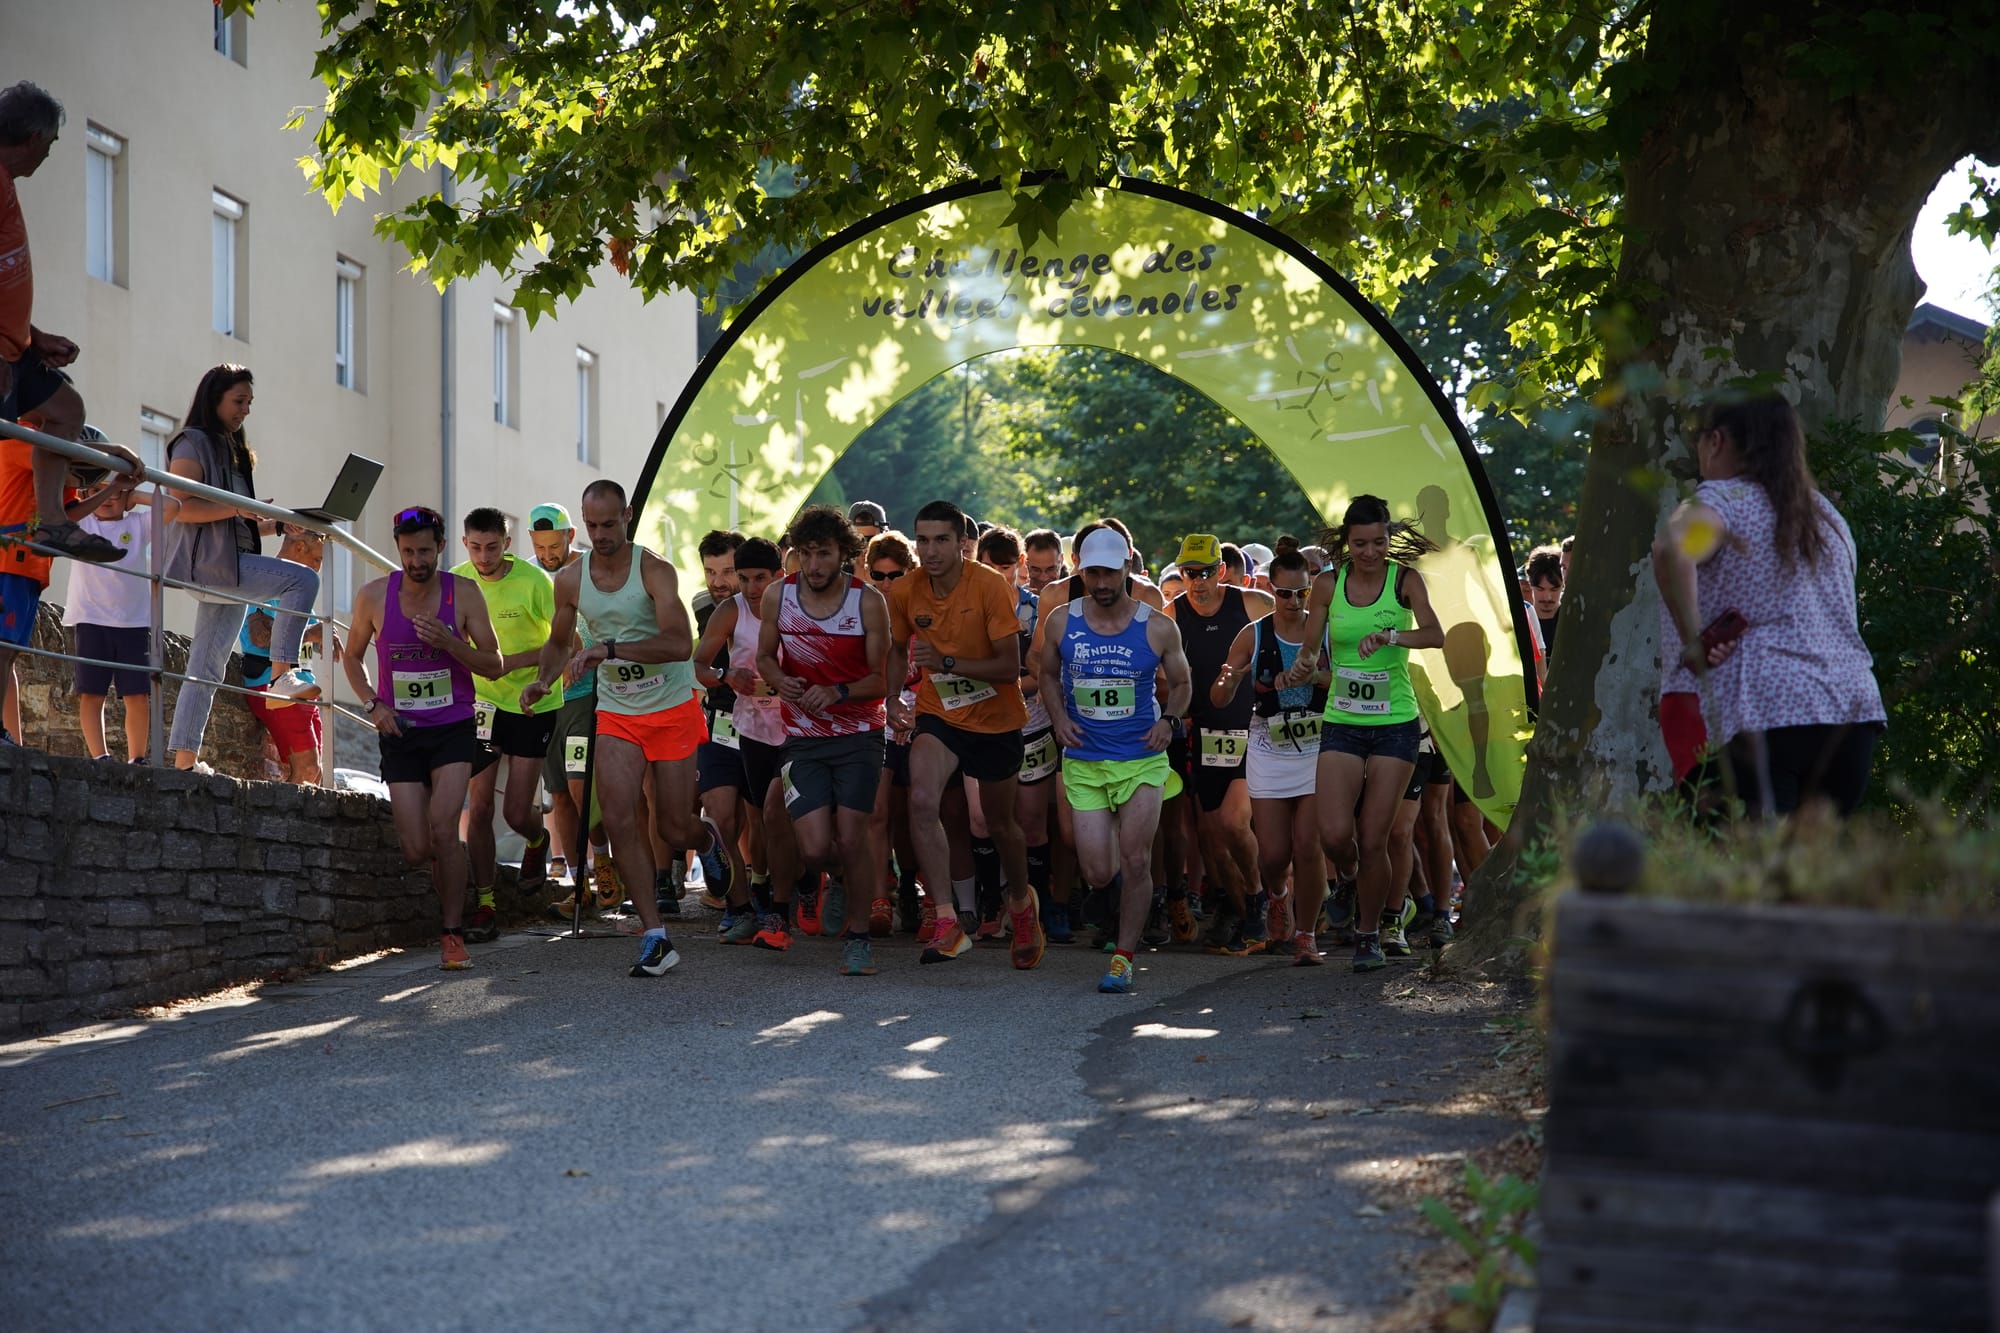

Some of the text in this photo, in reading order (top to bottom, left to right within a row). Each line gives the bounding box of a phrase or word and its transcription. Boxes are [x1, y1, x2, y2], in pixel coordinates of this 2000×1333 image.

[888, 243, 1216, 289] Challenge des
[1048, 282, 1242, 319] cévenoles
[617, 664, 645, 682] 99
[408, 681, 435, 698] 91
[947, 680, 975, 695] 73
[1348, 681, 1375, 700] 90
[1090, 689, 1119, 706] 18
[1278, 719, 1318, 740] 101
[573, 746, 585, 760] 8
[1214, 738, 1236, 754] 13
[1025, 748, 1046, 768] 57
